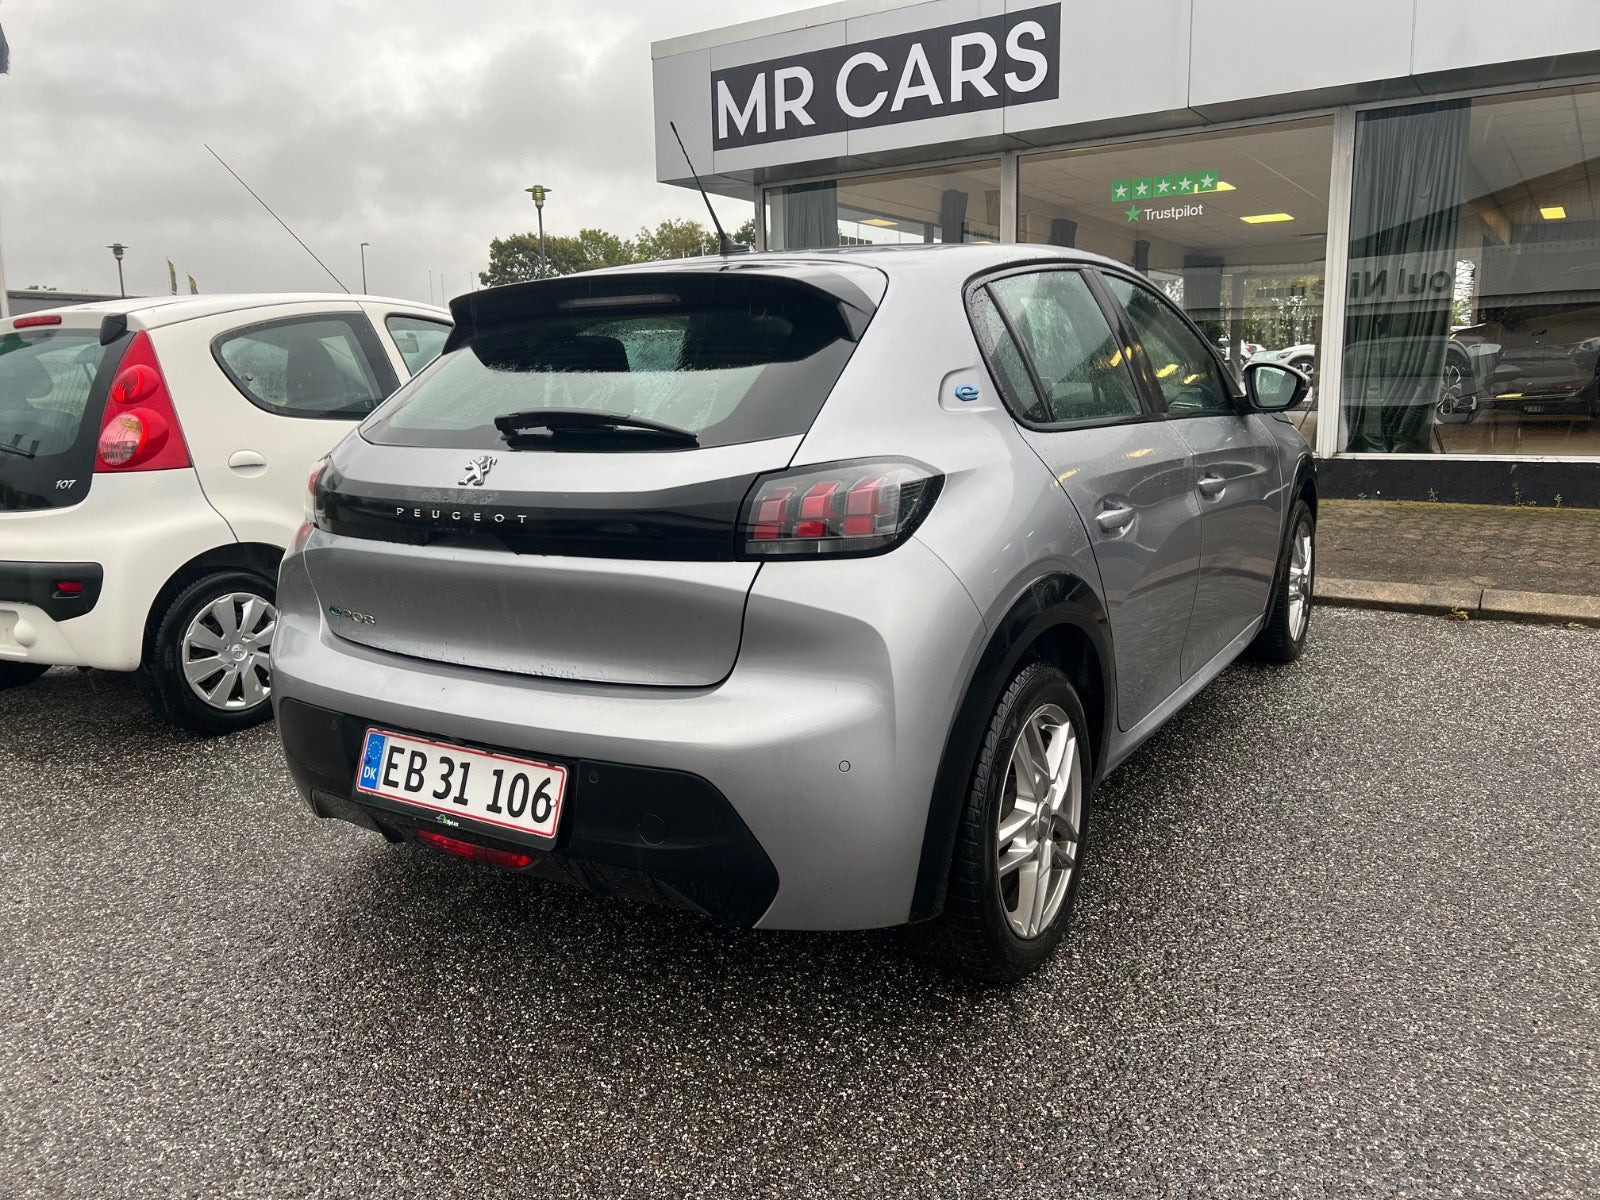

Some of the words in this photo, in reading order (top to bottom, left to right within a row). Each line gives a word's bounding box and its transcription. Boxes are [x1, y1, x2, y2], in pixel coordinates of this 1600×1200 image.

[716, 65, 816, 139] MR
[836, 20, 1048, 119] CARS
[1143, 204, 1204, 221] Trustpilot
[55, 479, 77, 490] 107
[395, 507, 528, 524] PEUGEOT
[363, 765, 377, 781] DK
[382, 744, 428, 793] EB
[432, 756, 471, 806] 31
[486, 769, 552, 824] 106
